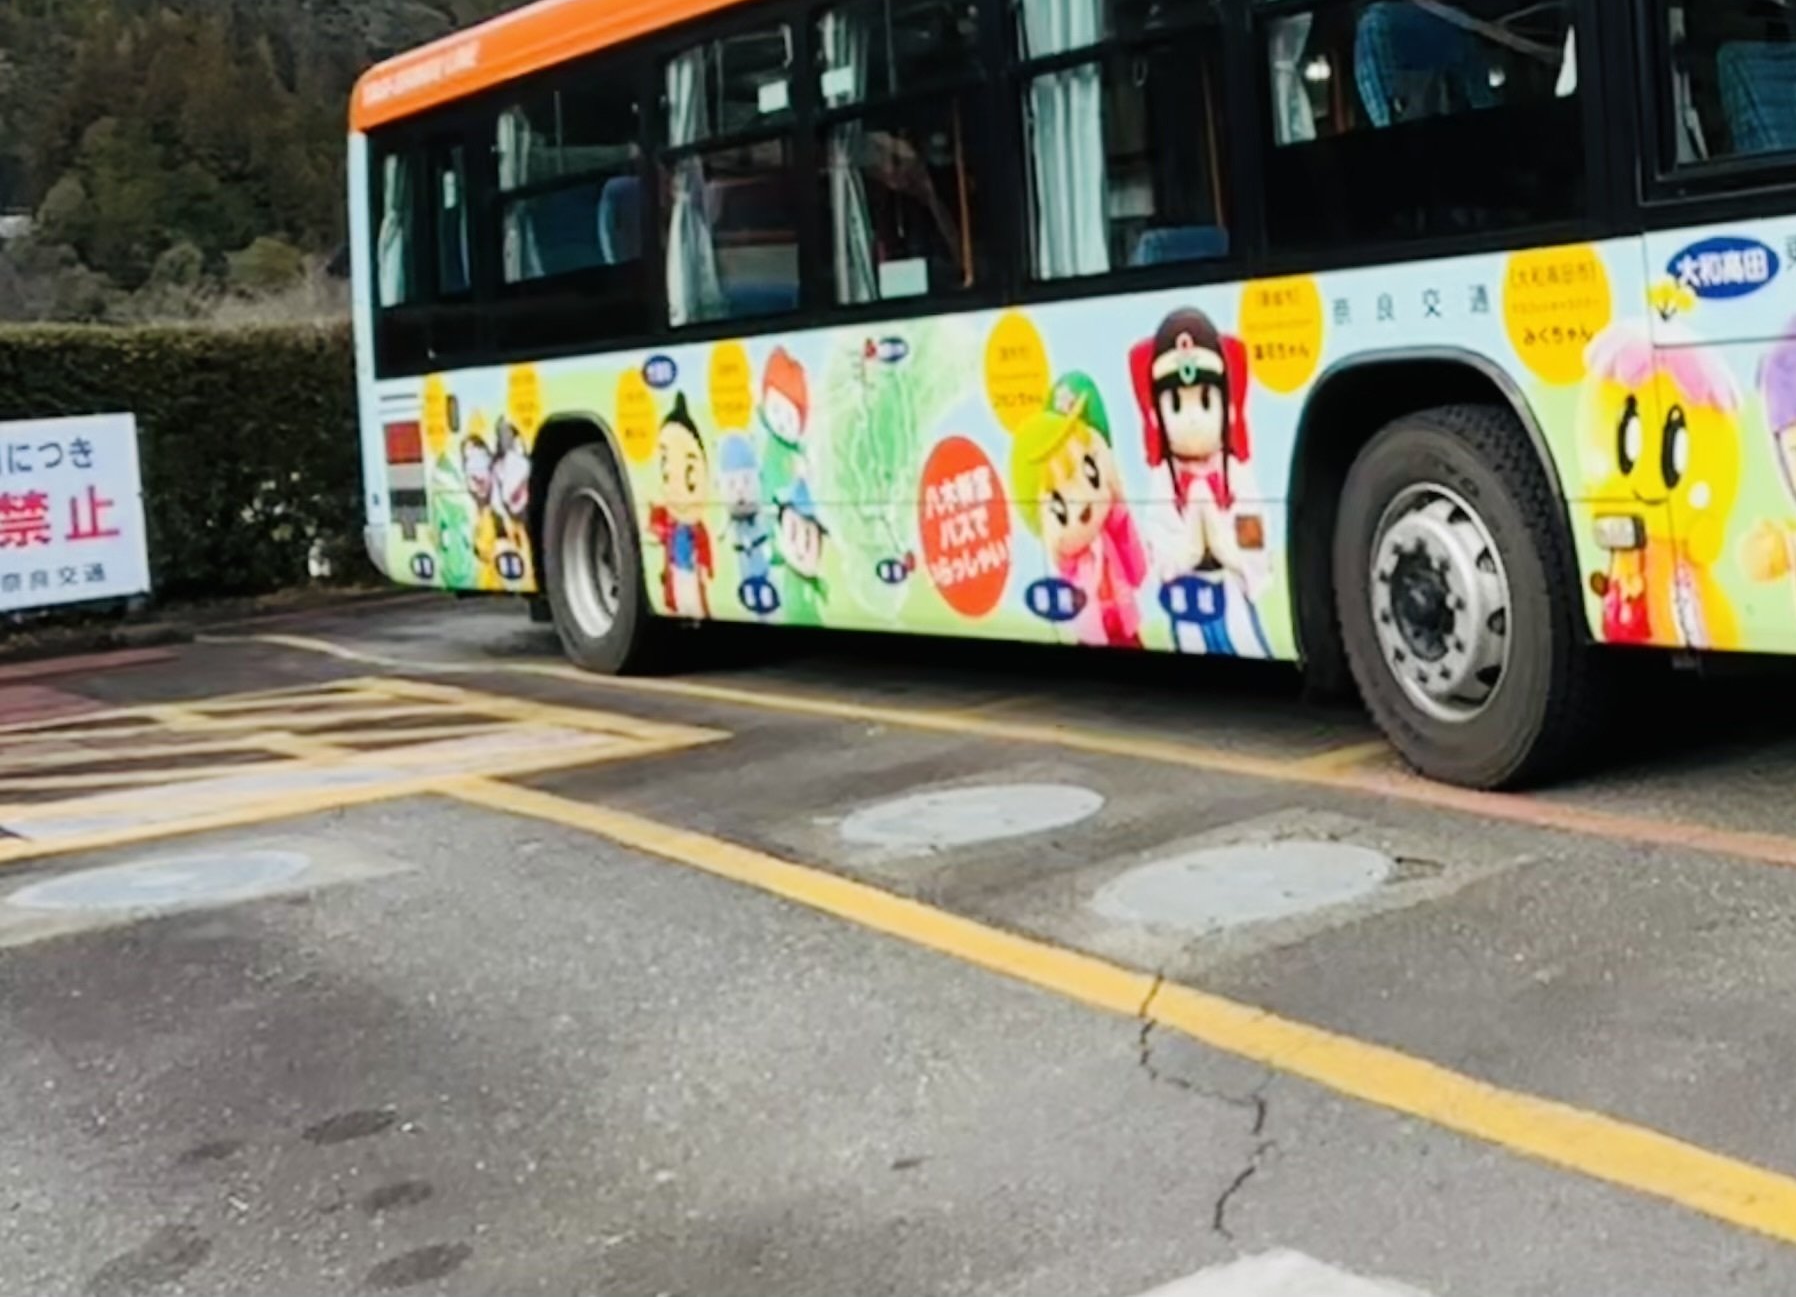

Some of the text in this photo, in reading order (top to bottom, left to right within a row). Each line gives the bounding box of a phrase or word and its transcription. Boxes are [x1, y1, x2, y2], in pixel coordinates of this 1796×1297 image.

[1676, 248, 1770, 288] 大和高田
[0, 436, 94, 474] につき
[0, 485, 120, 547] 禁止
